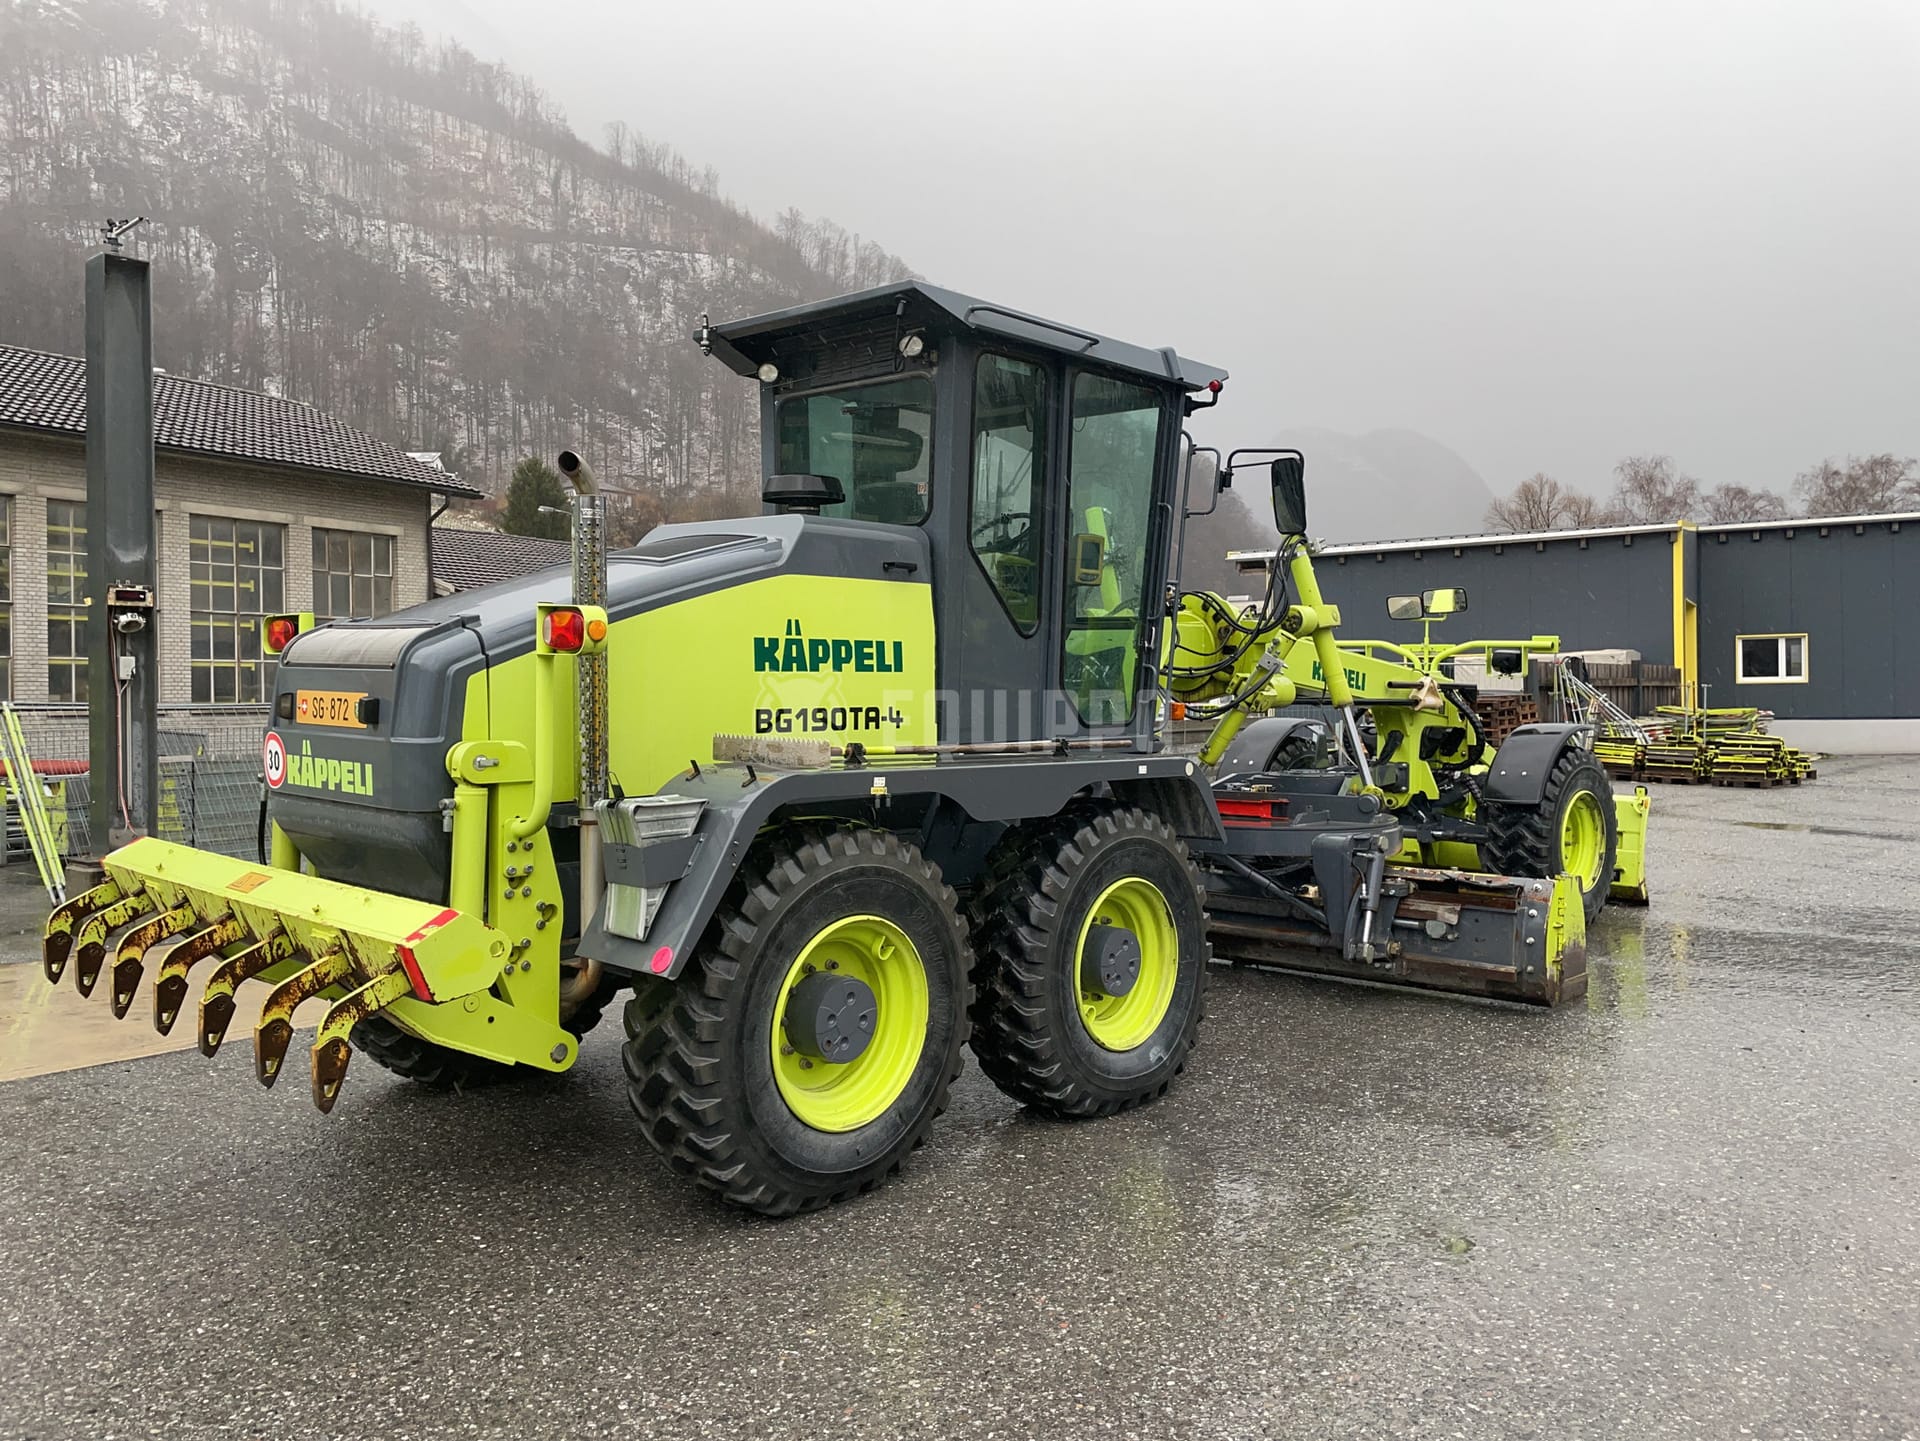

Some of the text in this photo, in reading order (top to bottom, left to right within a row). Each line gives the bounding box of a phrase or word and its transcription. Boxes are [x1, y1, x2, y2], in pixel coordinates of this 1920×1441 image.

[753, 618, 903, 673] KÄPPELI
[1311, 660, 1366, 692] KELI
[755, 706, 904, 734] BG190TA-4
[268, 749, 280, 771] 30
[286, 739, 374, 797] KÄPPELI
